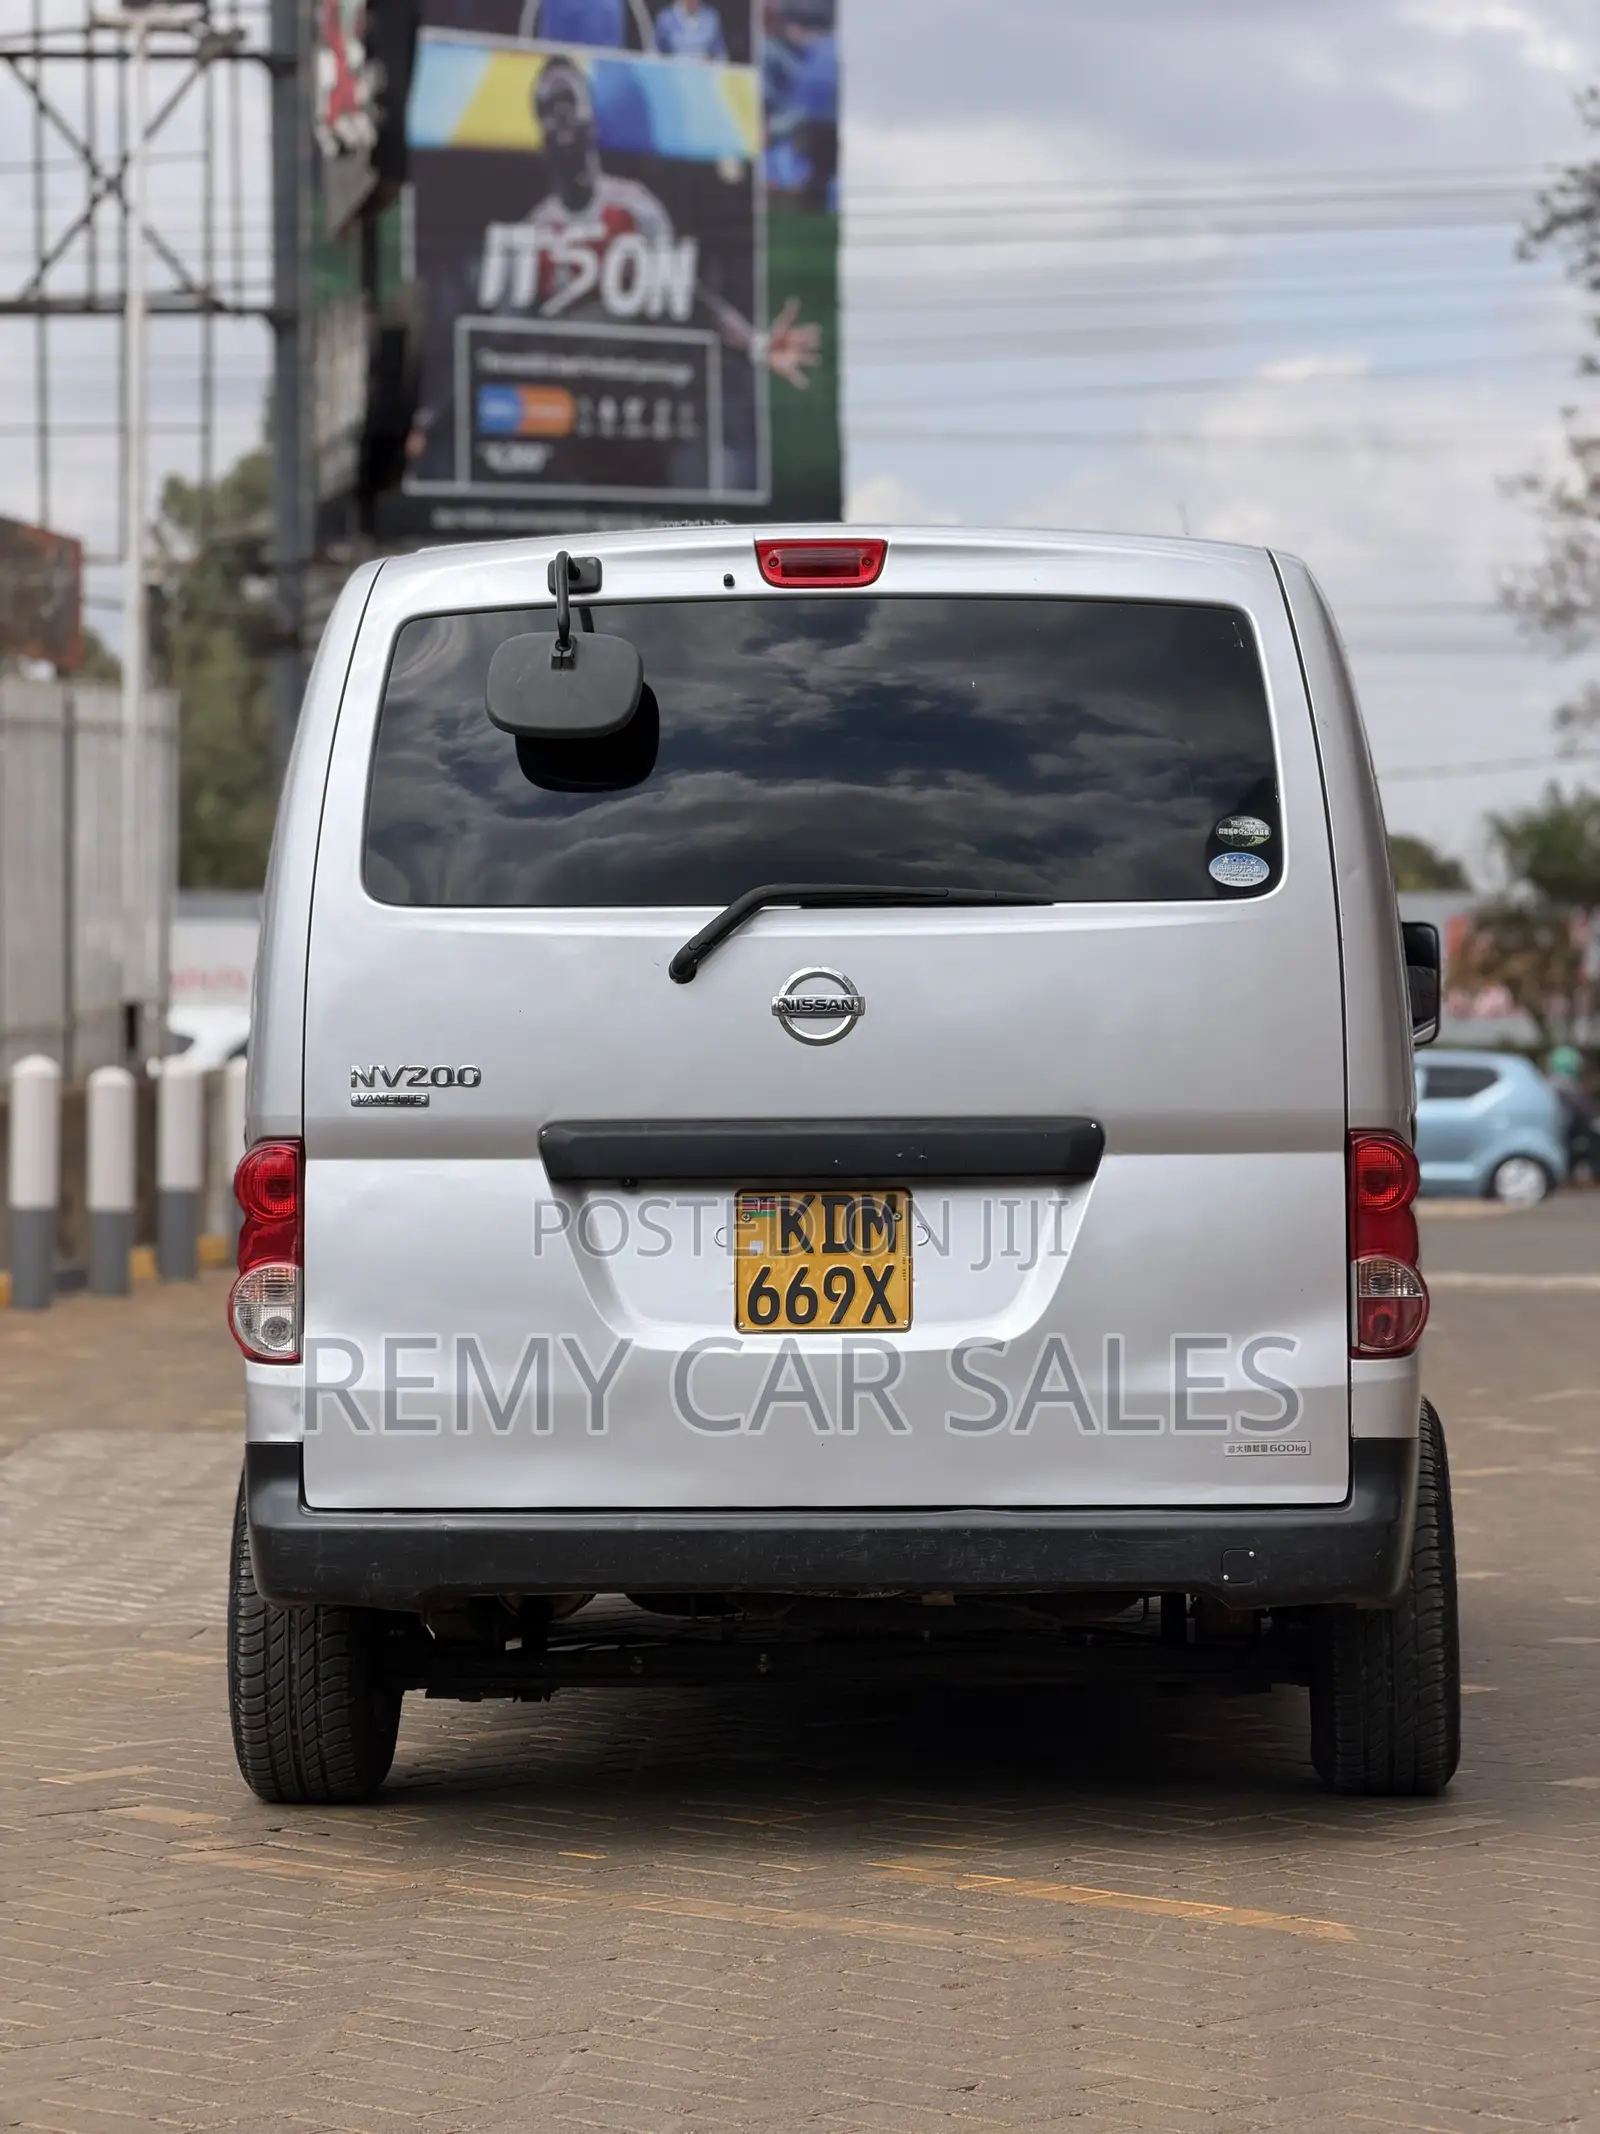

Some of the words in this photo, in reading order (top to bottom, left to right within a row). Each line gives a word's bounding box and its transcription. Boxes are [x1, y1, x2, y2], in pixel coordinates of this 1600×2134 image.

[781, 999, 855, 1012] NISSAN
[351, 1064, 482, 1088] NV200
[780, 1194, 898, 1254] KDM
[747, 1264, 897, 1326] 669X
